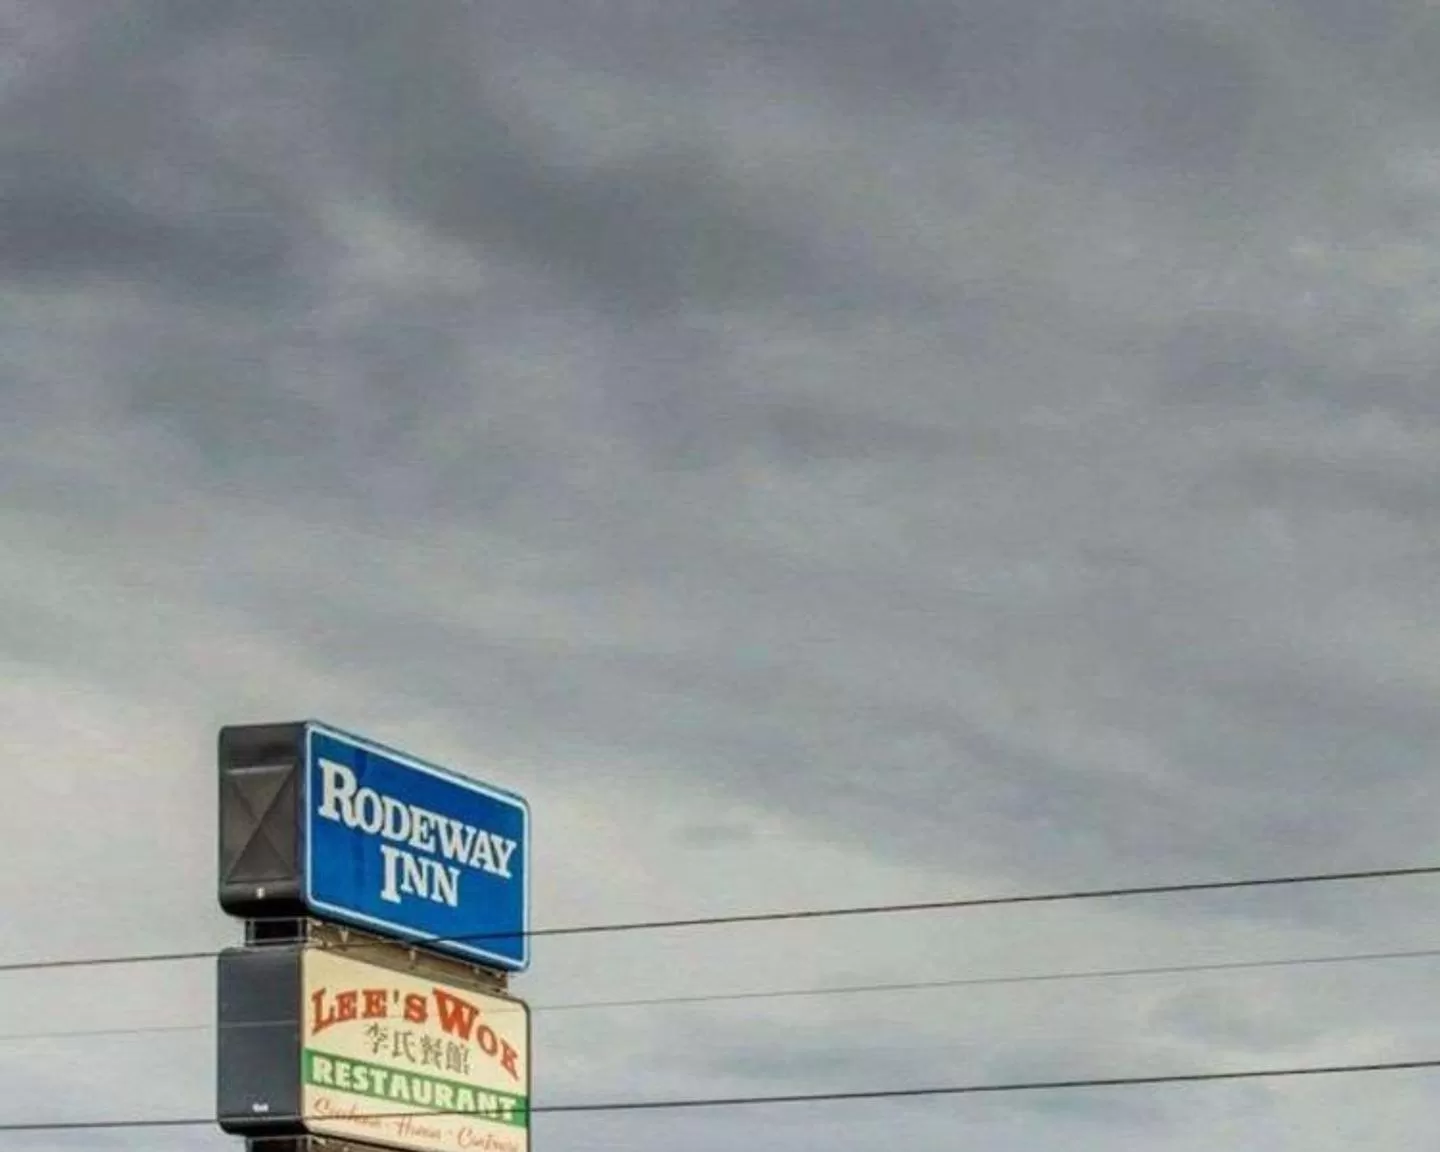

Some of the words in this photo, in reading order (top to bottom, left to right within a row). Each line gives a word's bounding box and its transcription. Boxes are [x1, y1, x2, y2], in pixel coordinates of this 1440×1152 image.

[318, 758, 516, 879] RODEWAY
[380, 844, 462, 907] INN
[311, 987, 428, 1036] LEE'S
[432, 986, 519, 1081] WOK
[312, 1054, 517, 1121] RESTAURANT
